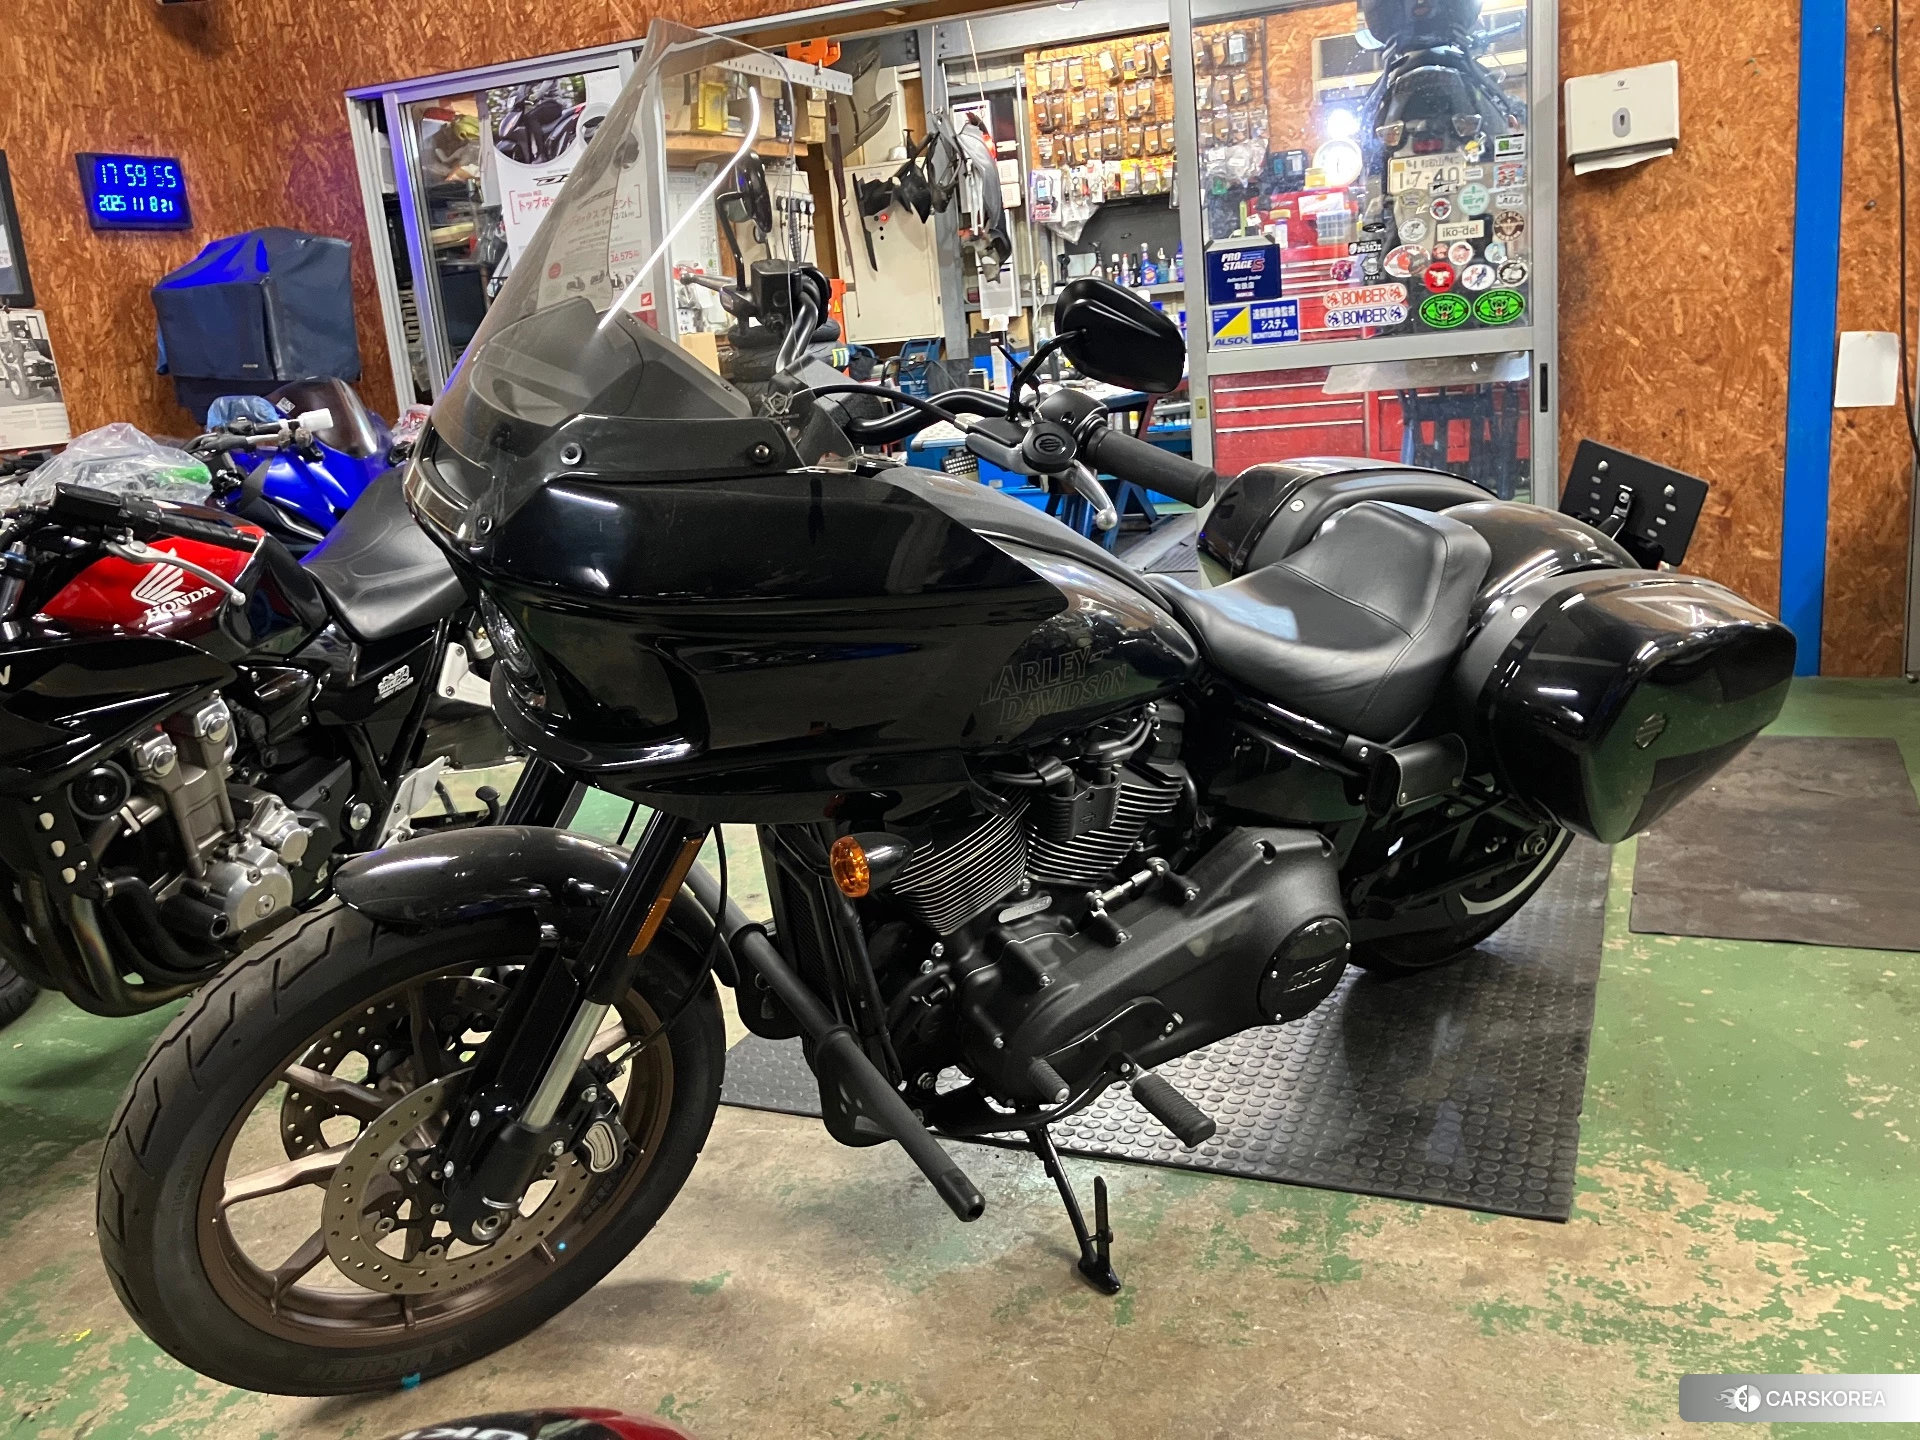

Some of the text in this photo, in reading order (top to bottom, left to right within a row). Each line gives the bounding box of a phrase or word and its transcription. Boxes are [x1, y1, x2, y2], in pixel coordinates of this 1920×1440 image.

[102, 163, 177, 188] 17 59 55
[149, 196, 158, 212] 8
[1442, 223, 1479, 237] iko-de!
[1221, 252, 1241, 262] PRO
[1223, 260, 1253, 271] STAGE
[1341, 287, 1387, 306] BOMBER
[1261, 318, 1288, 330] システム
[1342, 308, 1387, 325] BOMBER
[1283, 328, 1298, 337] AREA
[1214, 336, 1249, 346] ALSOK
[144, 586, 216, 625] HONDA
[1000, 663, 1127, 725] DAVIDSON
